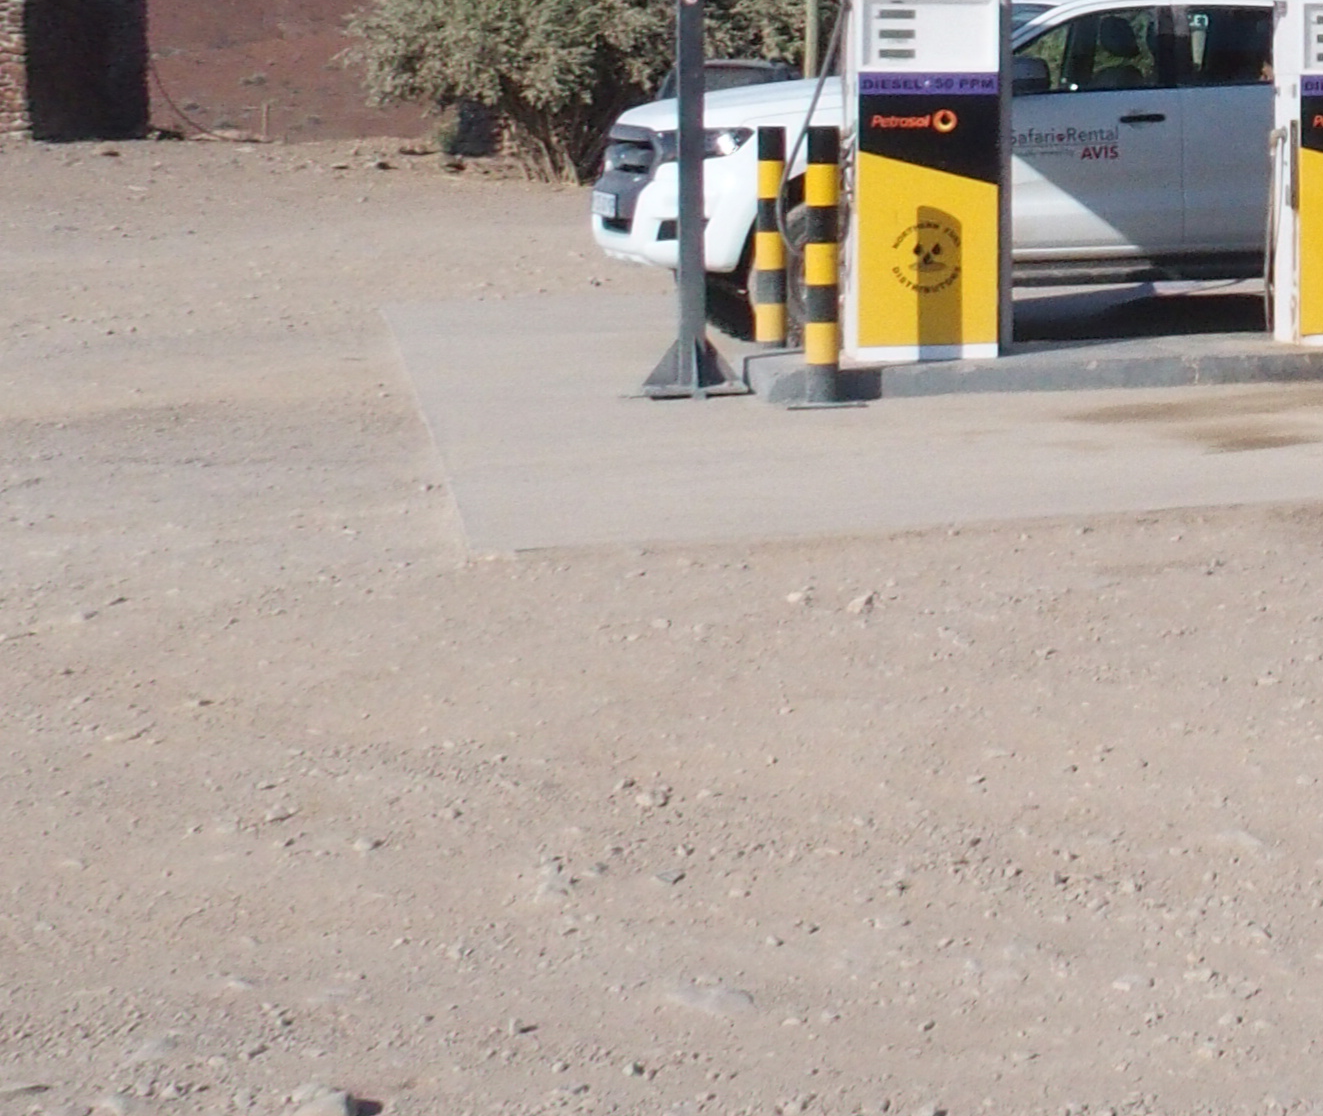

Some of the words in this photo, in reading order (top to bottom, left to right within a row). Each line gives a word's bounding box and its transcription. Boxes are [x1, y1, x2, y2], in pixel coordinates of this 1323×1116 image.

[862, 78, 923, 90] DIESEL
[959, 77, 995, 89] PPM
[871, 114, 931, 129] Petrosol
[1081, 145, 1119, 160] AVIS
